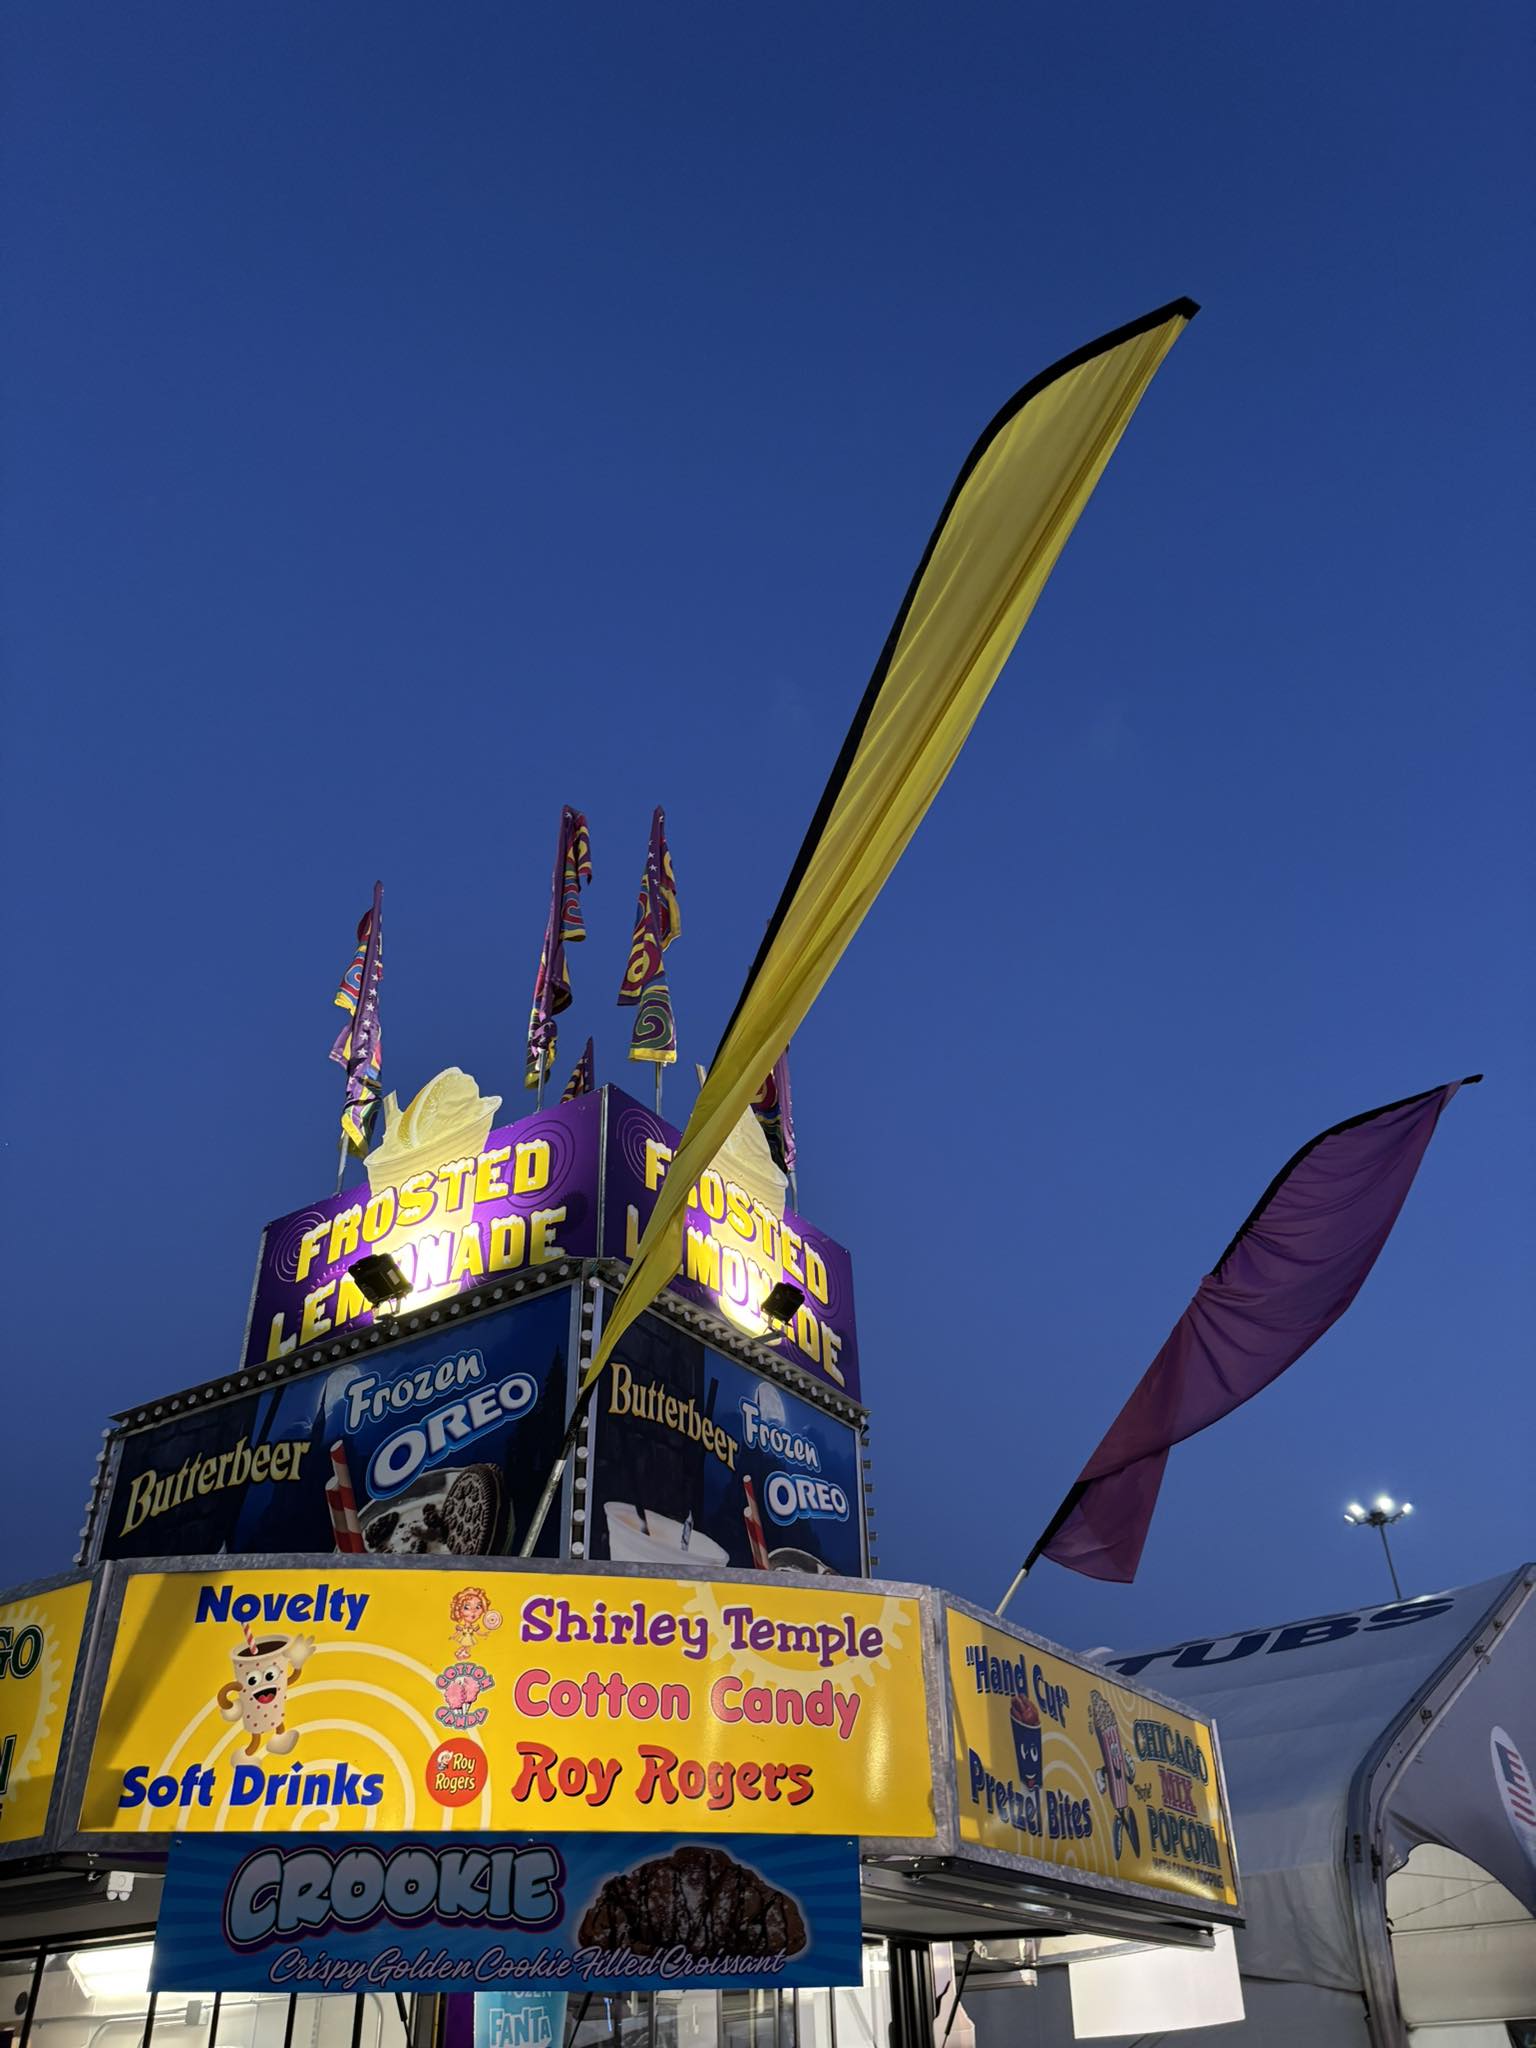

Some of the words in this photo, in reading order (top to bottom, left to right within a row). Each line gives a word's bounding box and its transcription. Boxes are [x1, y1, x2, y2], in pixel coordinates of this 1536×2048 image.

[295, 1138, 551, 1283] FROSTED
[644, 1137, 829, 1305] FOSTED
[625, 1203, 846, 1388] LMONDE
[345, 1347, 483, 1434] Frozen
[608, 1362, 739, 1471] Butterbeer
[368, 1374, 538, 1495] OREO
[740, 1400, 820, 1470] Frozen
[119, 1436, 310, 1538] Butterbeer
[766, 1474, 849, 1518] OREO
[194, 1584, 369, 1630] Novelty
[521, 1597, 709, 1660] Shirley
[723, 1605, 885, 1667] Temple
[1104, 1597, 1455, 1677] TUBS
[435, 1662, 495, 1691] COTTON
[514, 1669, 691, 1721] Cotton
[711, 1676, 862, 1740] Candy
[119, 1764, 215, 1809] Soft
[228, 1760, 384, 1807] Drinks
[435, 1773, 475, 1794] Rogers
[452, 1752, 476, 1774] Roy
[510, 1741, 622, 1806] Roy
[634, 1743, 814, 1810] Rogers
[1133, 1719, 1208, 1786] CHICAGO
[969, 1747, 1044, 1837] Pretzel
[1046, 1789, 1093, 1840] Bites
[1158, 1765, 1197, 1817] MIX
[1147, 1805, 1221, 1869] POPCORN
[225, 1846, 562, 1946] CROOKIE
[269, 1947, 368, 1989] Crispy
[367, 1947, 473, 1987] Golden
[474, 1946, 572, 1982] Cookie
[572, 1945, 661, 1981] Filled
[659, 1945, 786, 1979] Croissant
[489, 2006, 553, 2047] FANTA
